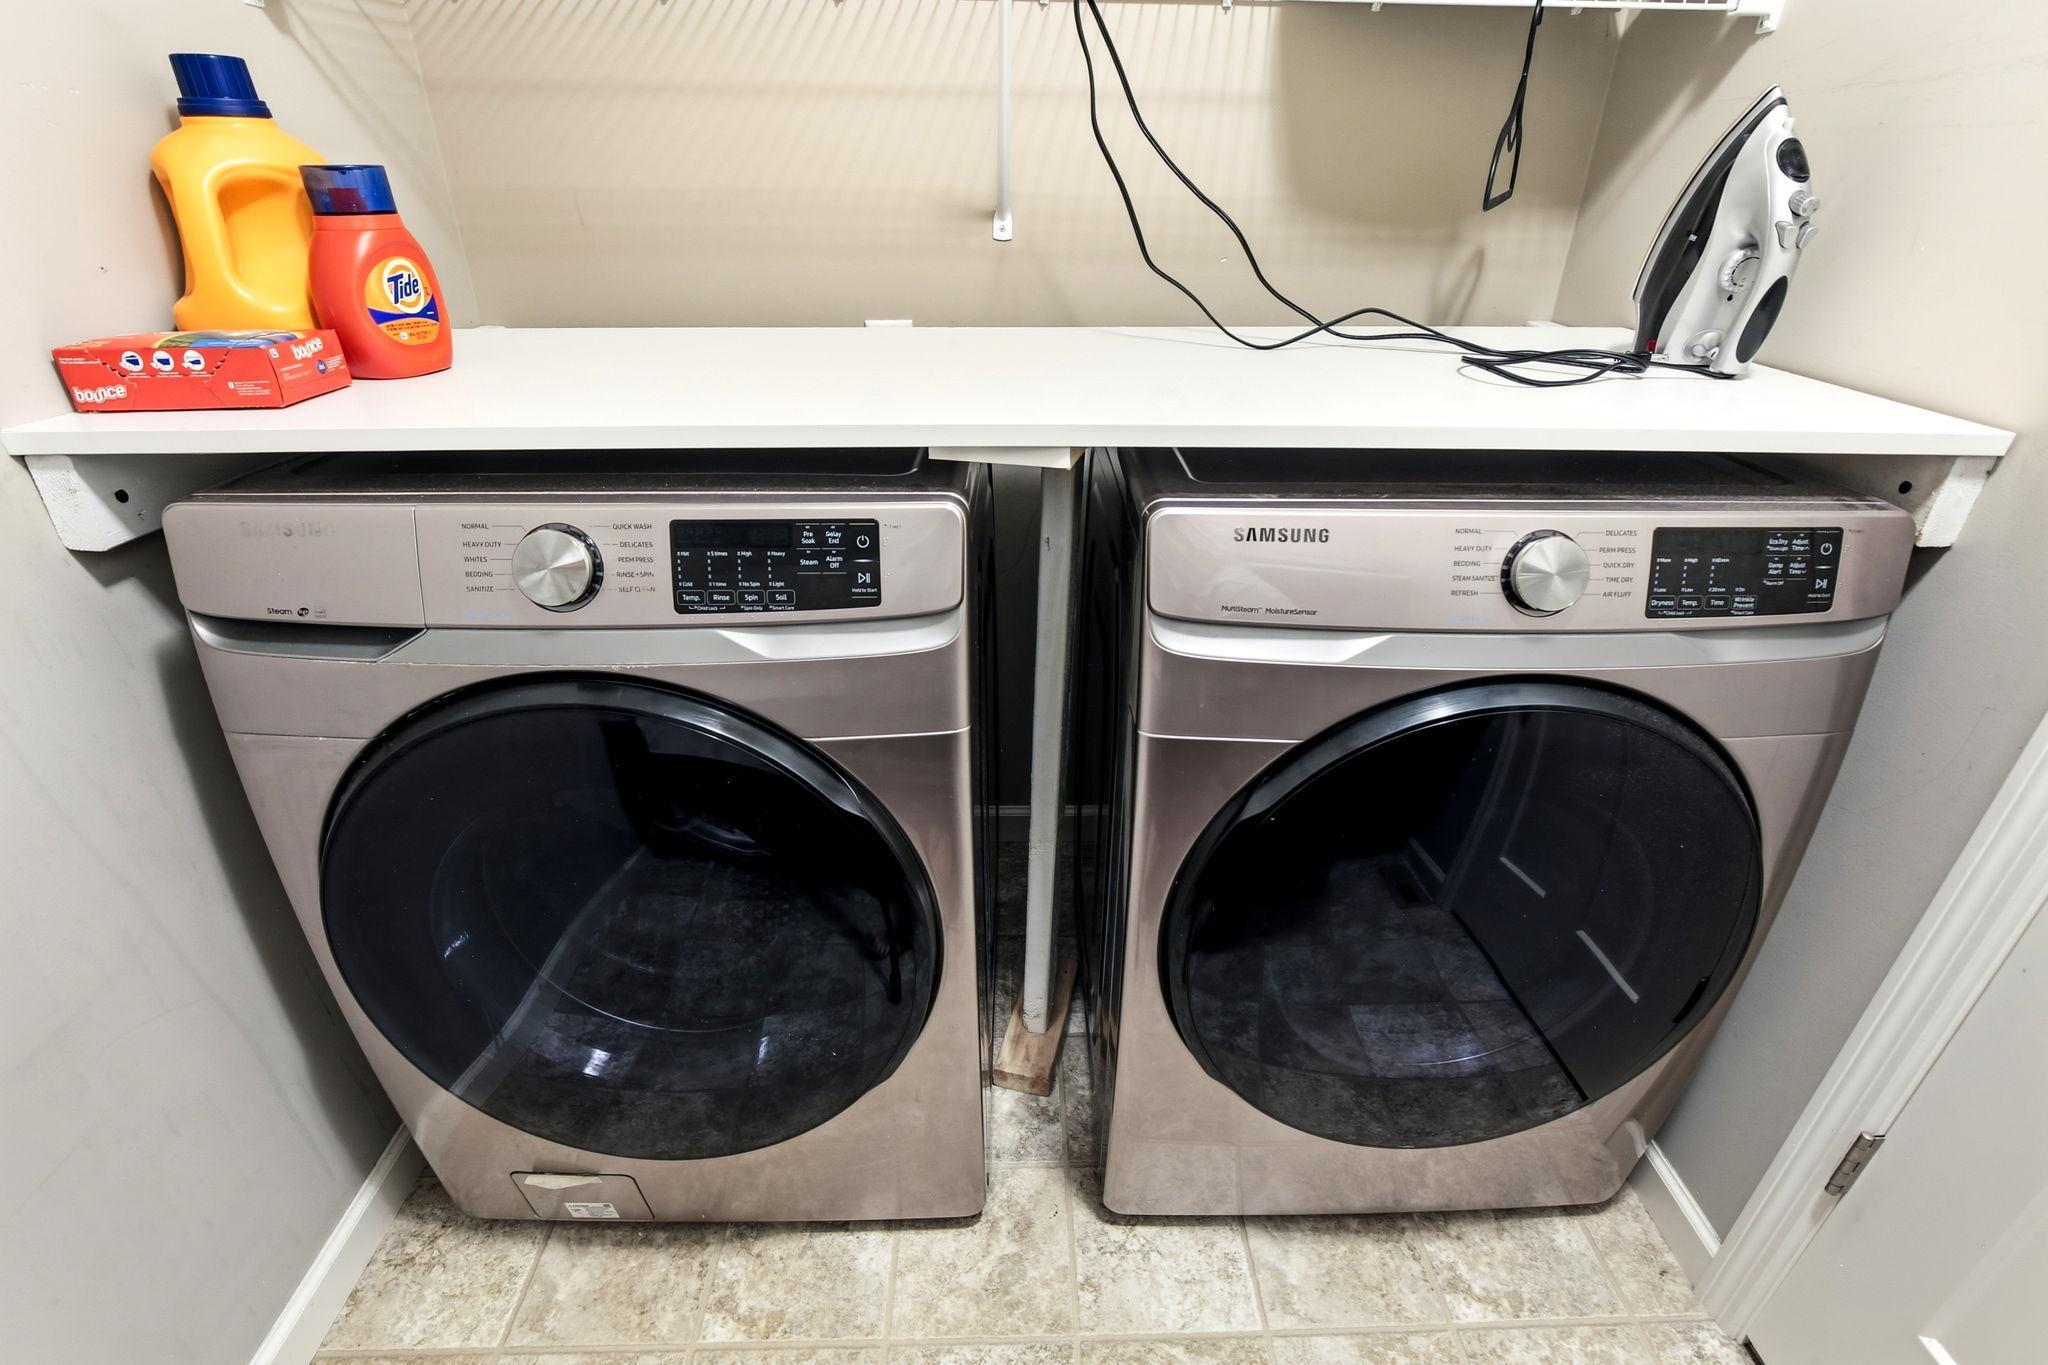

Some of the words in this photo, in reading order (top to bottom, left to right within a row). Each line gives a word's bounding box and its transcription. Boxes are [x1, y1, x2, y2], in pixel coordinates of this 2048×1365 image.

[386, 272, 420, 305] Tide
[291, 337, 324, 360] bounce
[73, 385, 127, 403] bounce
[1233, 527, 1330, 543] SAMSUNG
[744, 594, 759, 602] Spin
[1651, 599, 1674, 607] Dryness
[266, 607, 293, 615] Steam
[1264, 607, 1318, 616] MoistureSensor
